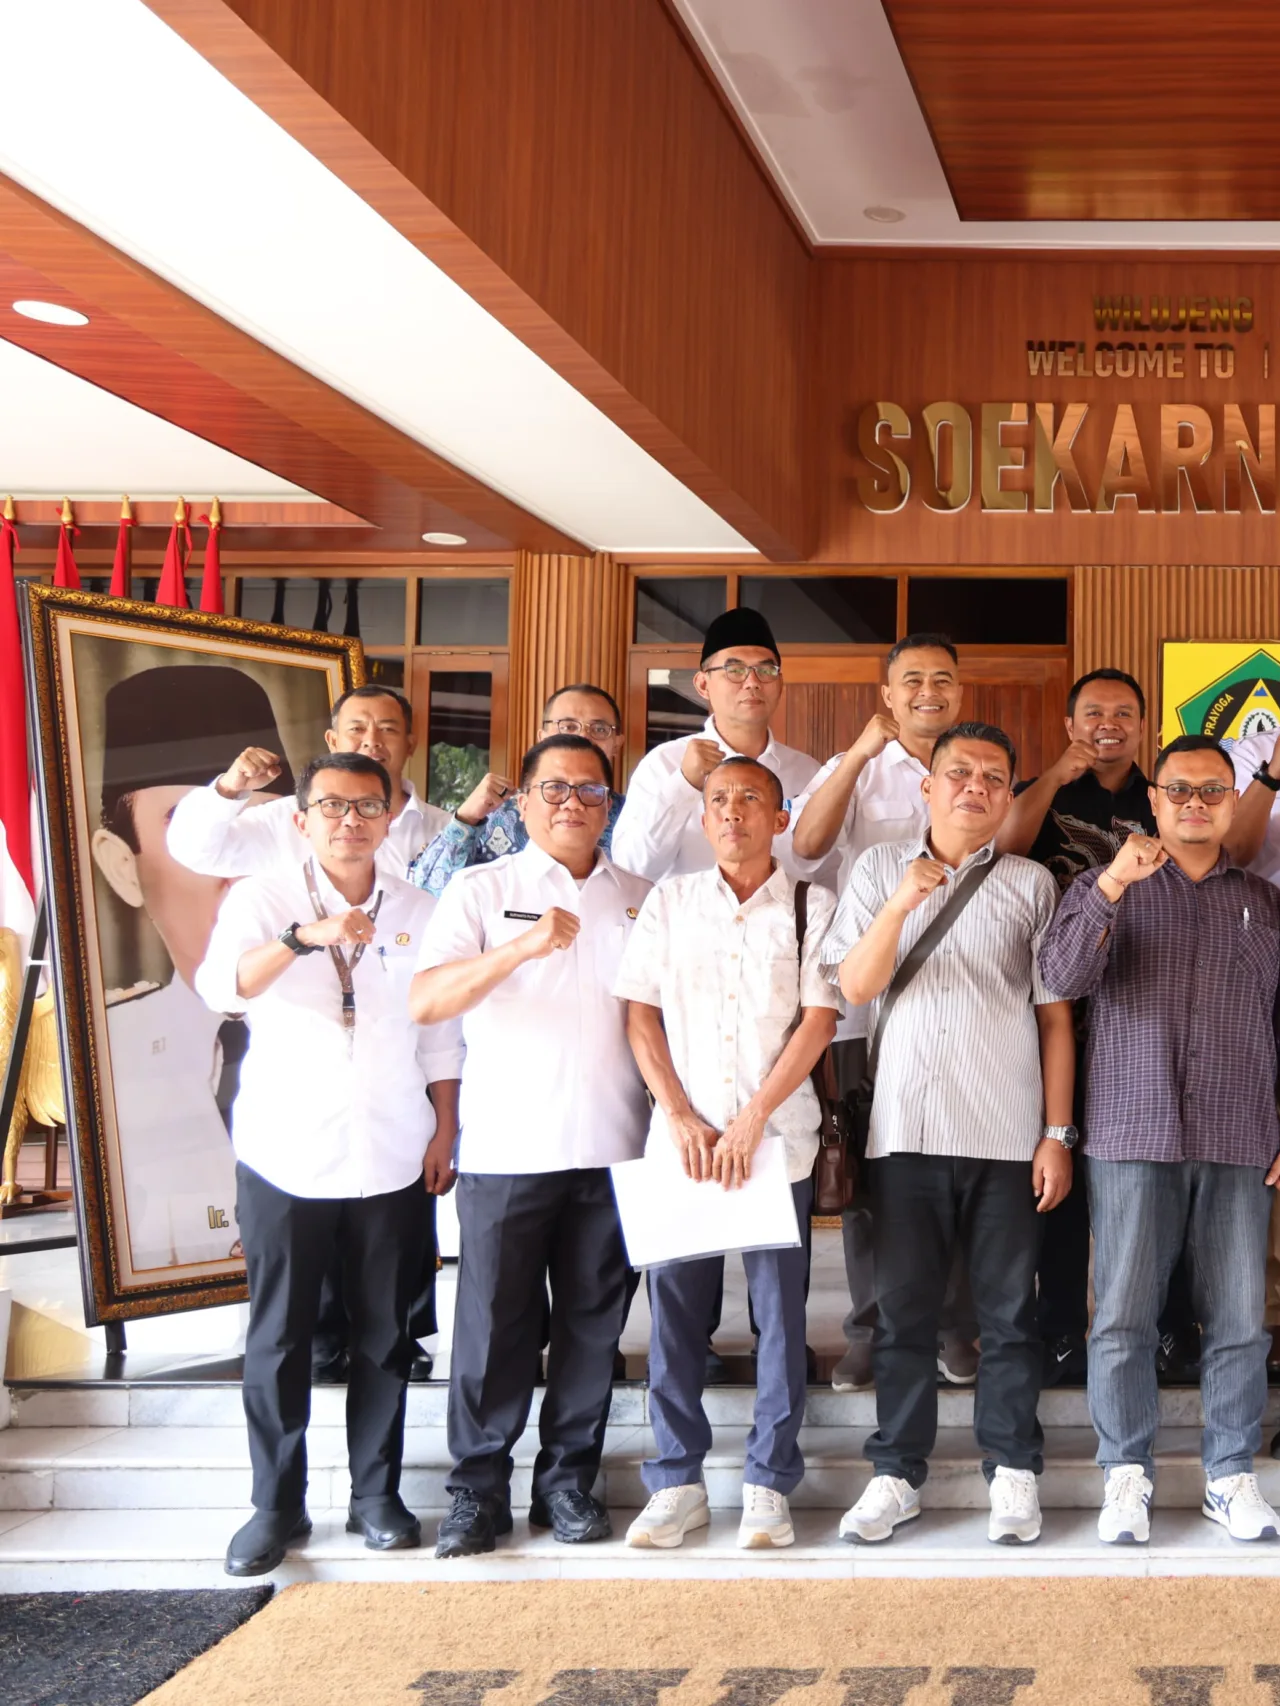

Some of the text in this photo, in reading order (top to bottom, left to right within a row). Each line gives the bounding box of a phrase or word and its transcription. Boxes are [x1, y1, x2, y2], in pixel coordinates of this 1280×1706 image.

[1093, 295, 1254, 332] WILUJENG
[1026, 340, 1235, 379] WELCOME TO
[1203, 693, 1234, 737] PRAYOGA
[207, 1205, 230, 1229] Ir.
